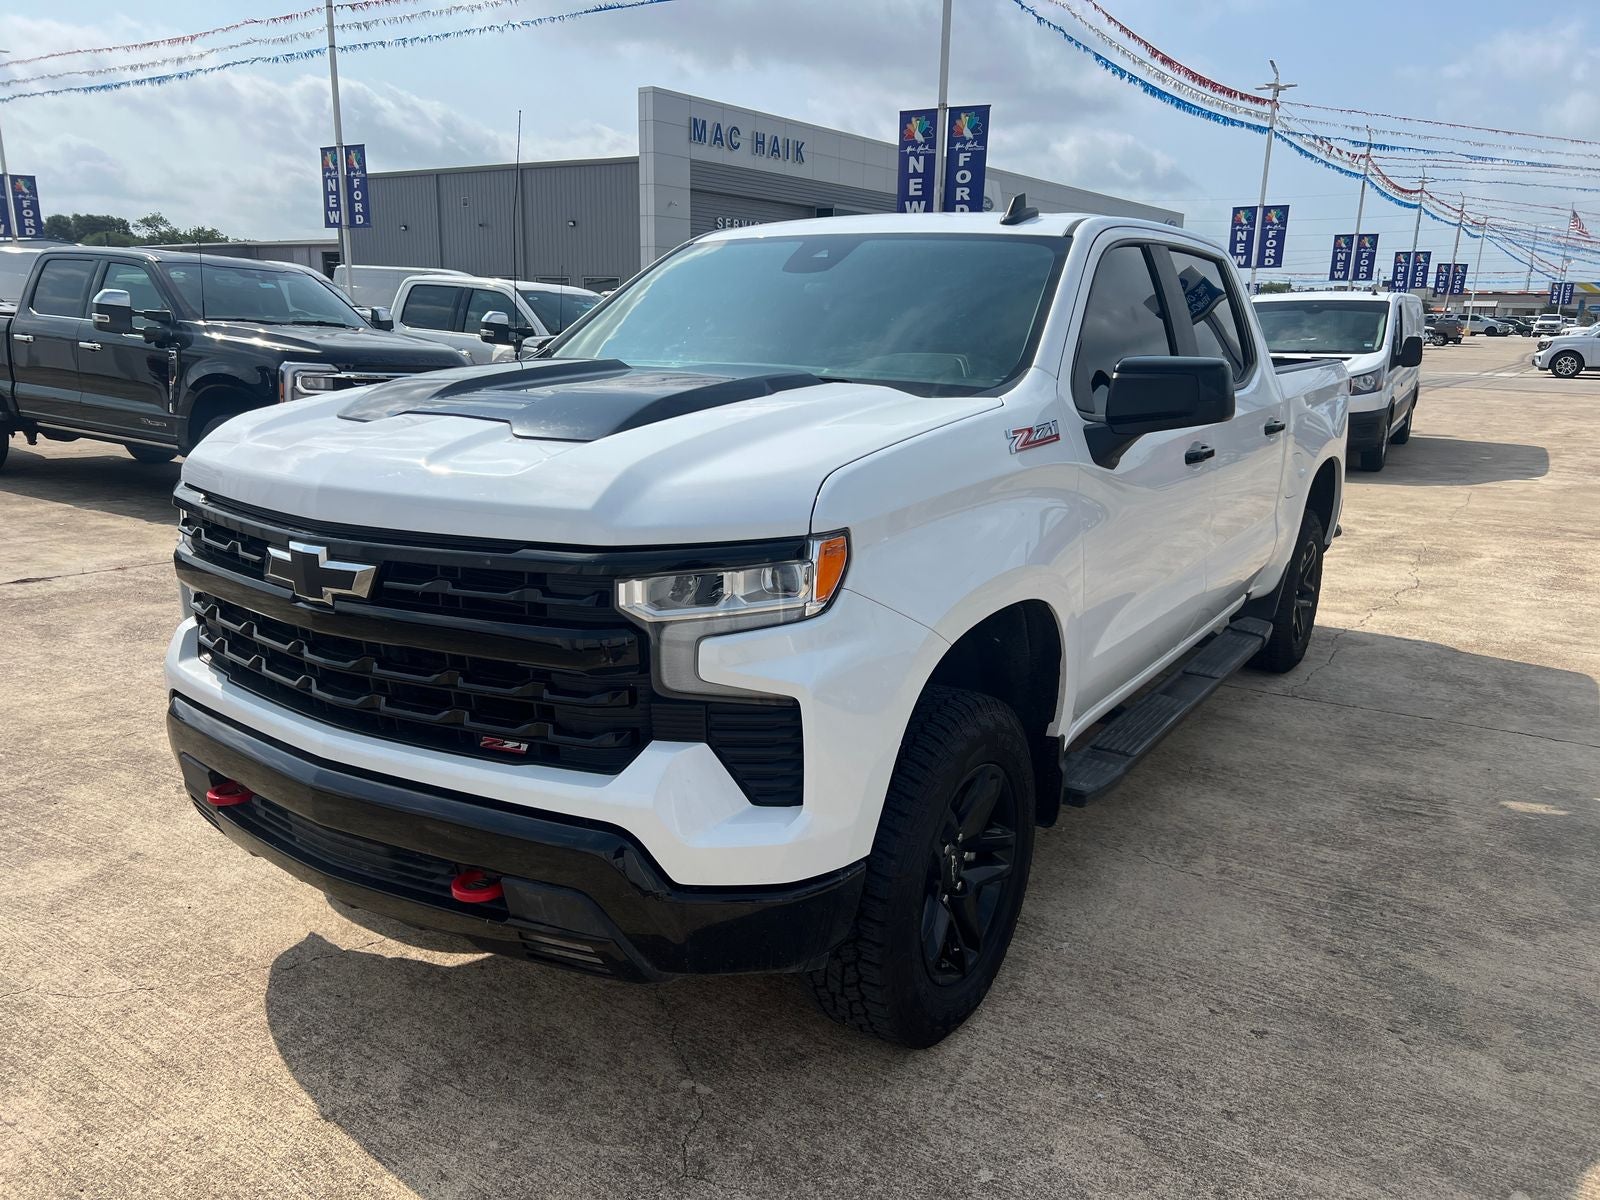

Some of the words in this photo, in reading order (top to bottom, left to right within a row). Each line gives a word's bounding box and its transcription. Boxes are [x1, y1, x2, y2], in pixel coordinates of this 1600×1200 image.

[691, 117, 741, 151] MAC
[755, 131, 805, 163] HAIK
[904, 155, 926, 213] NEW
[955, 152, 972, 213] FORD
[22, 199, 36, 236] FORD
[327, 178, 340, 224] NEW
[353, 178, 365, 225] FORD
[1233, 231, 1247, 265] NEW
[1264, 230, 1278, 266] FORD
[1334, 252, 1346, 279] NEW
[1358, 252, 1369, 279] FORD
[1395, 266, 1405, 287] NEW
[1415, 265, 1424, 287] FORD
[1437, 275, 1446, 293] NEW
[1453, 275, 1462, 294] FORD
[1005, 420, 1060, 455] Z71
[480, 736, 529, 754] Z71
